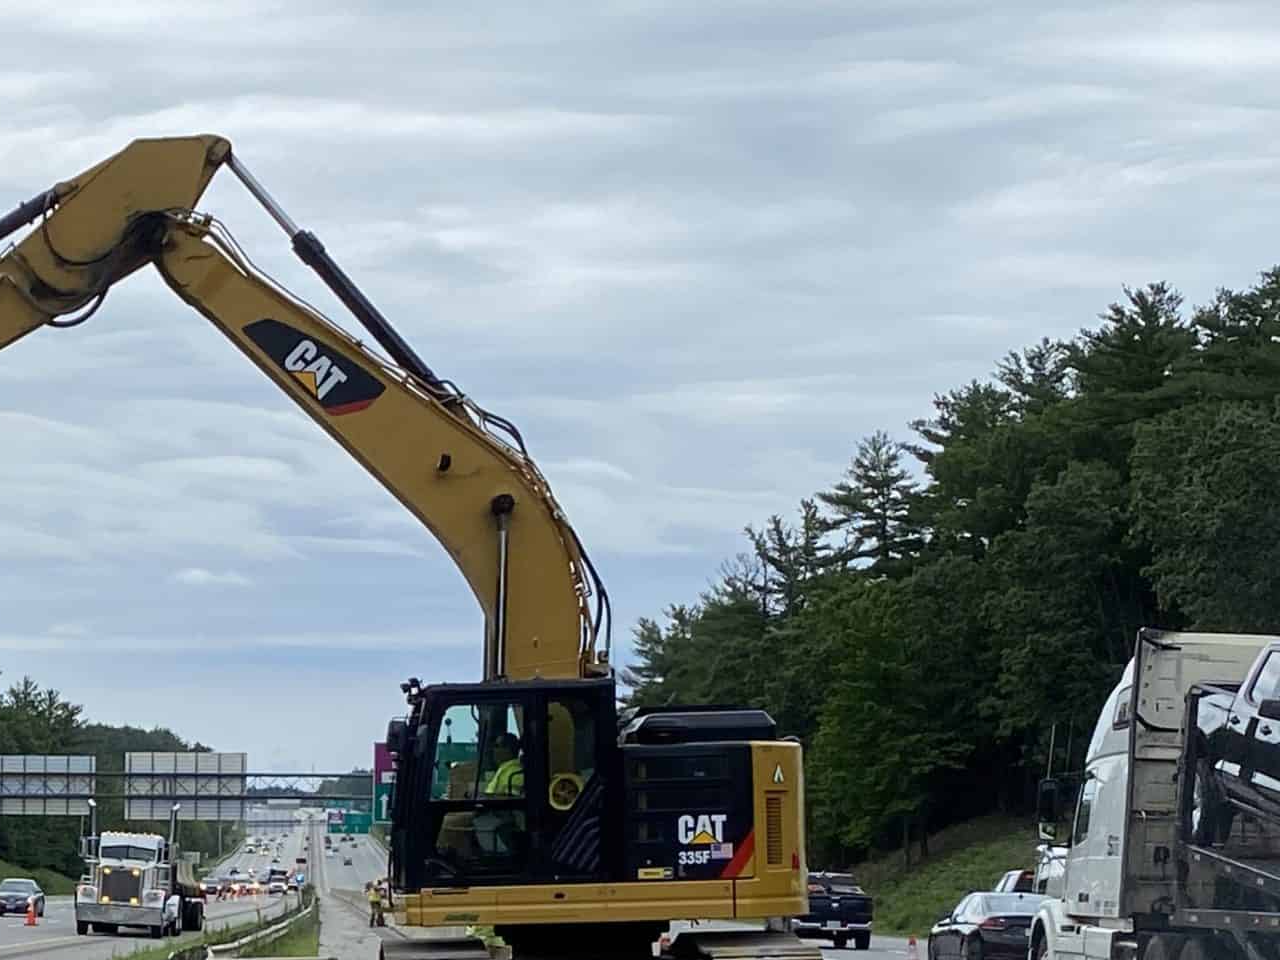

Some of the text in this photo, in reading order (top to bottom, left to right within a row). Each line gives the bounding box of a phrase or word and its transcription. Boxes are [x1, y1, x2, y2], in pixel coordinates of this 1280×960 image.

[284, 340, 348, 401] CAT
[678, 814, 728, 845] CAT
[678, 851, 710, 864] 335F
